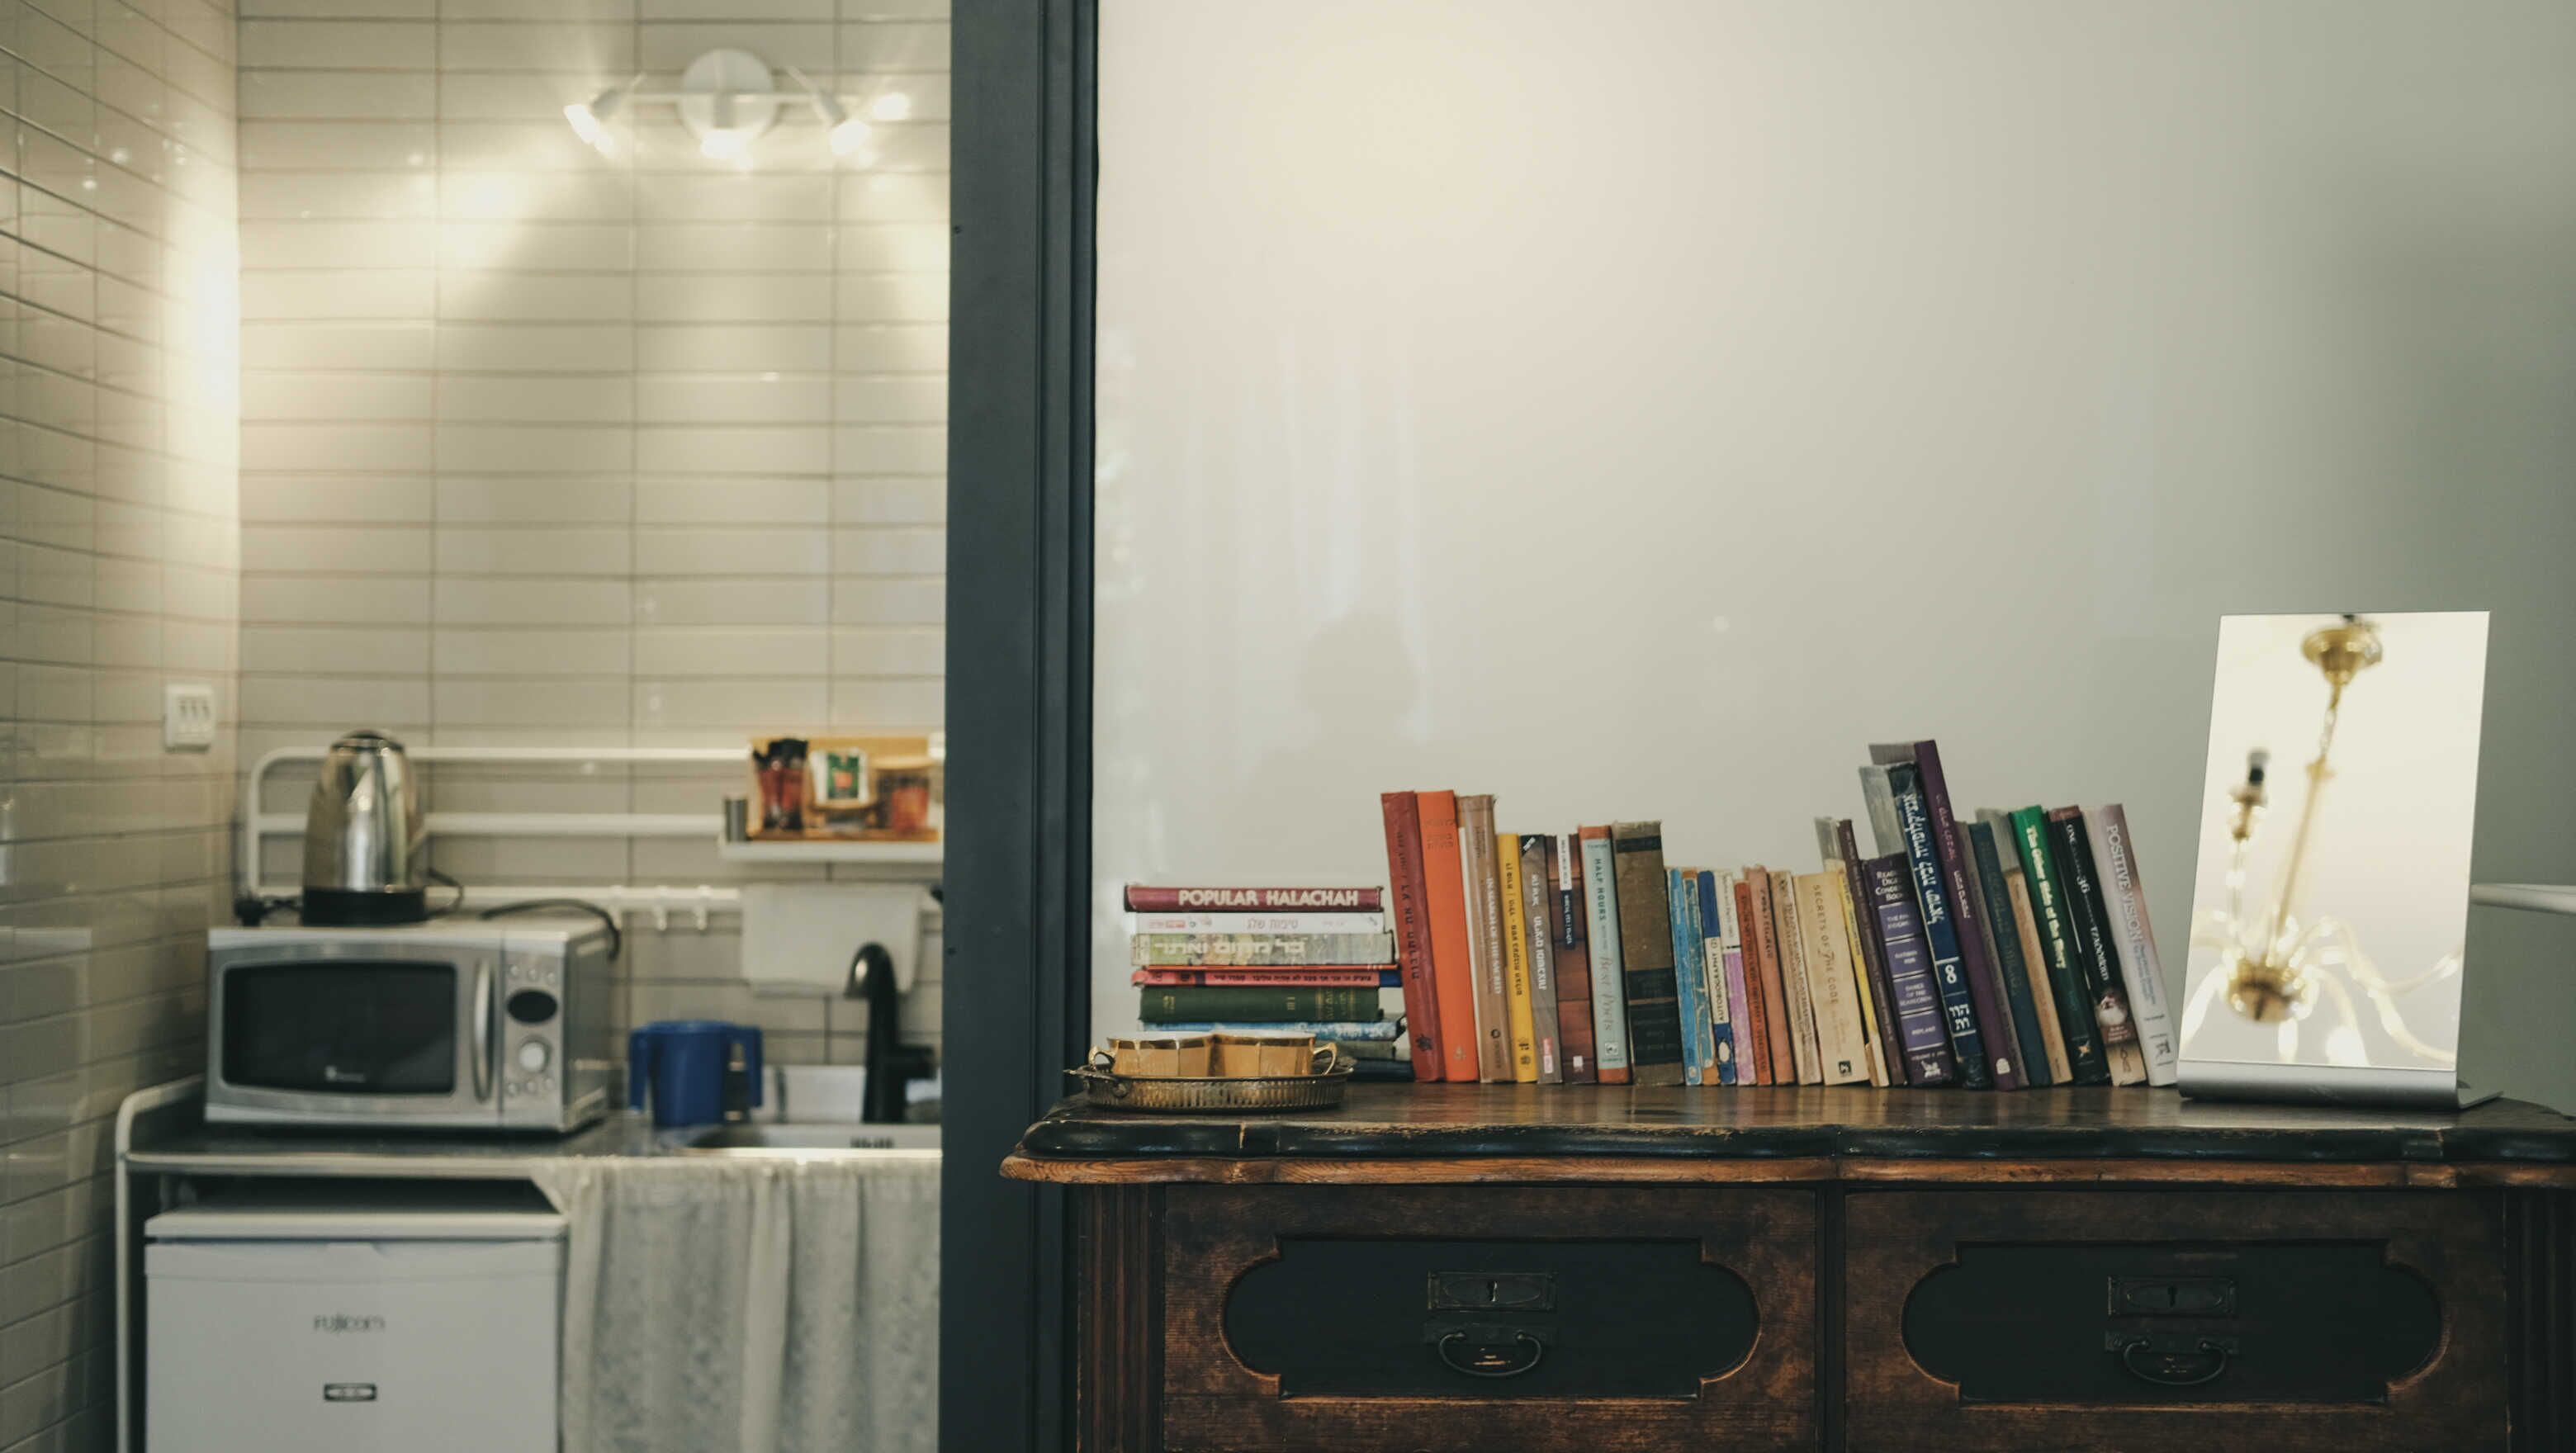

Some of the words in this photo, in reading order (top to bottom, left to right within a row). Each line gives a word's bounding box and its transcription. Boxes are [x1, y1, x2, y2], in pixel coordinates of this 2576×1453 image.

[1901, 792, 1930, 859] אנציקלופדיה
[2024, 825, 2041, 848] The
[1594, 858, 1603, 883] HALF
[2029, 847, 2048, 881] Other
[2063, 822, 2078, 845] ONE
[2074, 873, 2091, 895] 36
[1913, 860, 1936, 888] לבית
[2104, 823, 2132, 891] POSITIVE
[2119, 892, 2143, 940] VISION
[1178, 889, 1258, 906] POPULAR
[1266, 889, 1358, 906] HALACHAH
[1596, 887, 1607, 921] HOURS
[1811, 884, 1828, 931] SECRETS
[1924, 887, 1945, 925] ישראל
[2043, 905, 2057, 919] of
[1403, 906, 1413, 924] את
[2047, 917, 2062, 939] the
[1819, 934, 1830, 947] OF
[2048, 937, 2070, 970] Story
[1598, 956, 1615, 986] Best
[1816, 946, 1836, 973] THE
[1944, 964, 1957, 984] 8
[1711, 953, 1724, 1020] AUTOBIOGRAPHY
[1825, 976, 1840, 1005] CODE
[1599, 993, 1617, 1030] Poets
